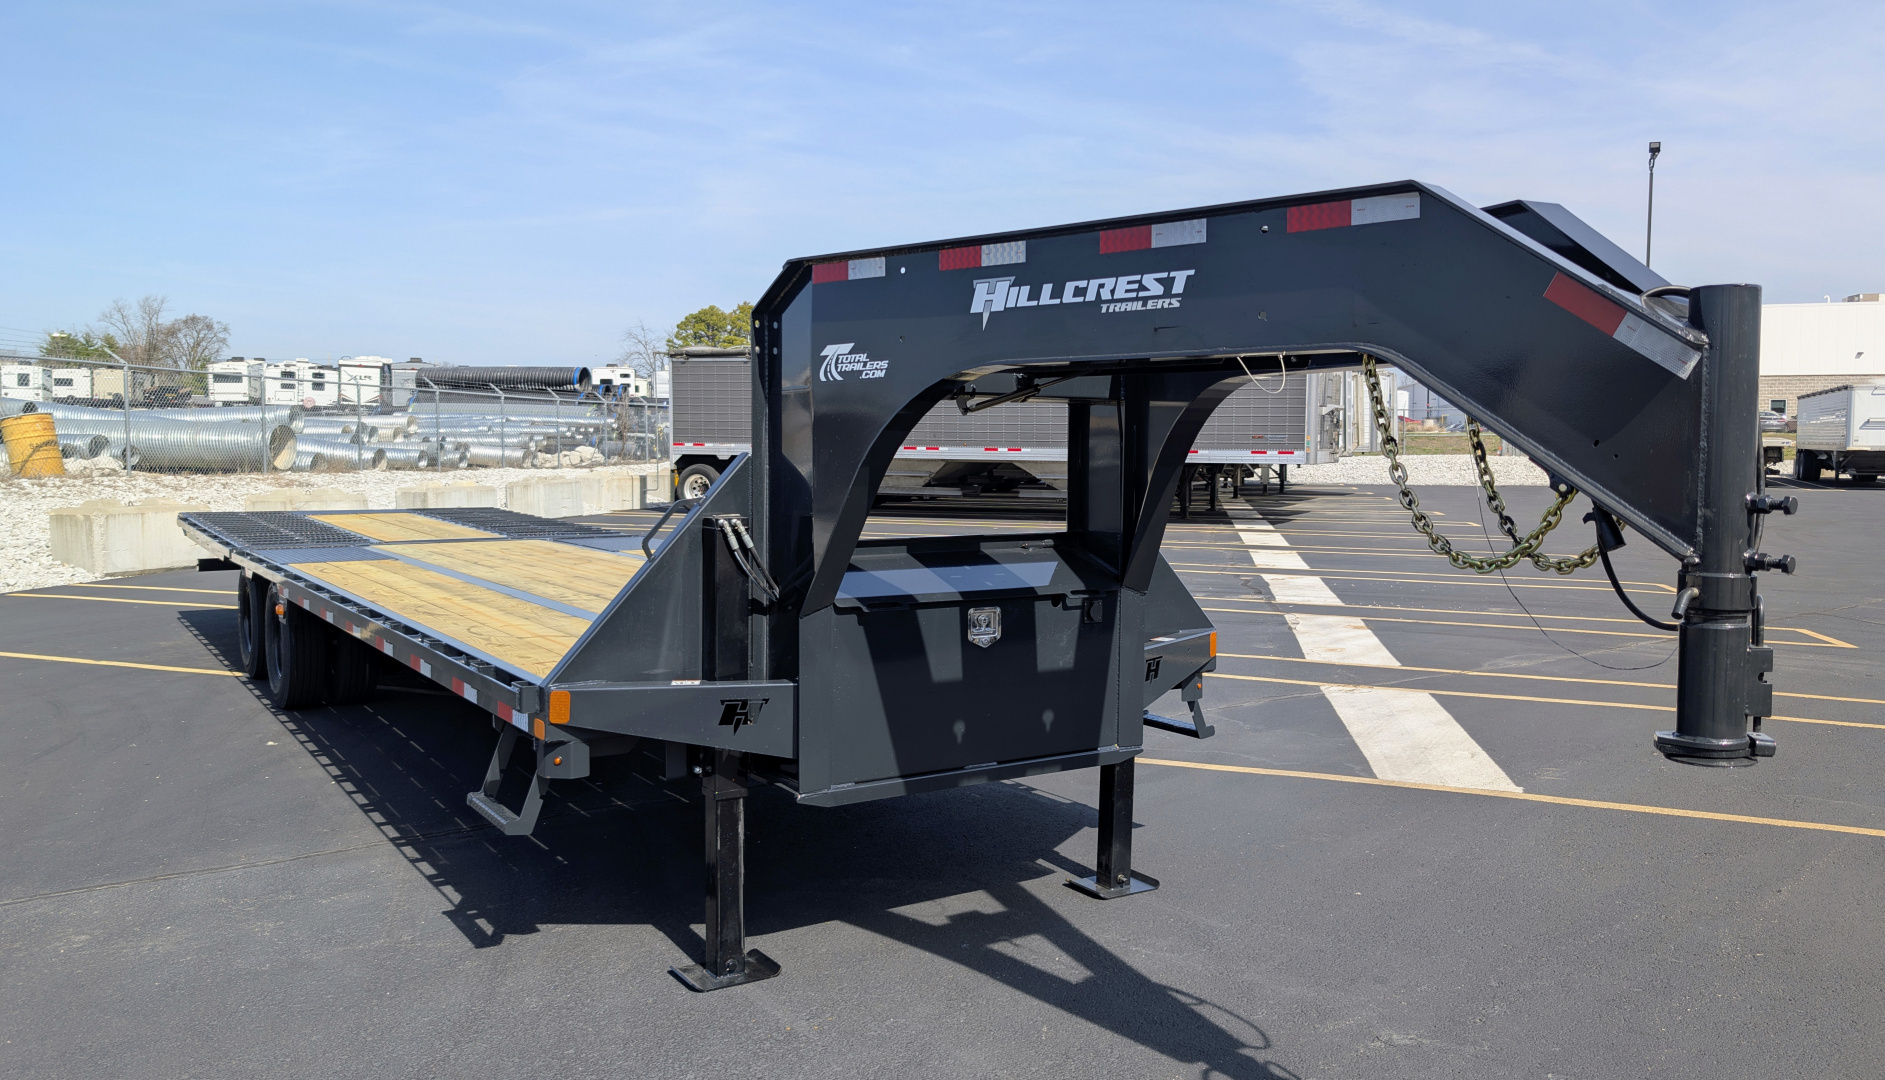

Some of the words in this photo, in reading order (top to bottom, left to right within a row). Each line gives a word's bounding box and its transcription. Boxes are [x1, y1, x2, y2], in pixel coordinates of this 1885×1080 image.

[970, 269, 1195, 326] HILLCREST
[1100, 297, 1182, 314] TRAILERS
[838, 353, 870, 364] TOTAL
[837, 360, 889, 372] TRAILERS
[859, 369, 886, 379] .COM
